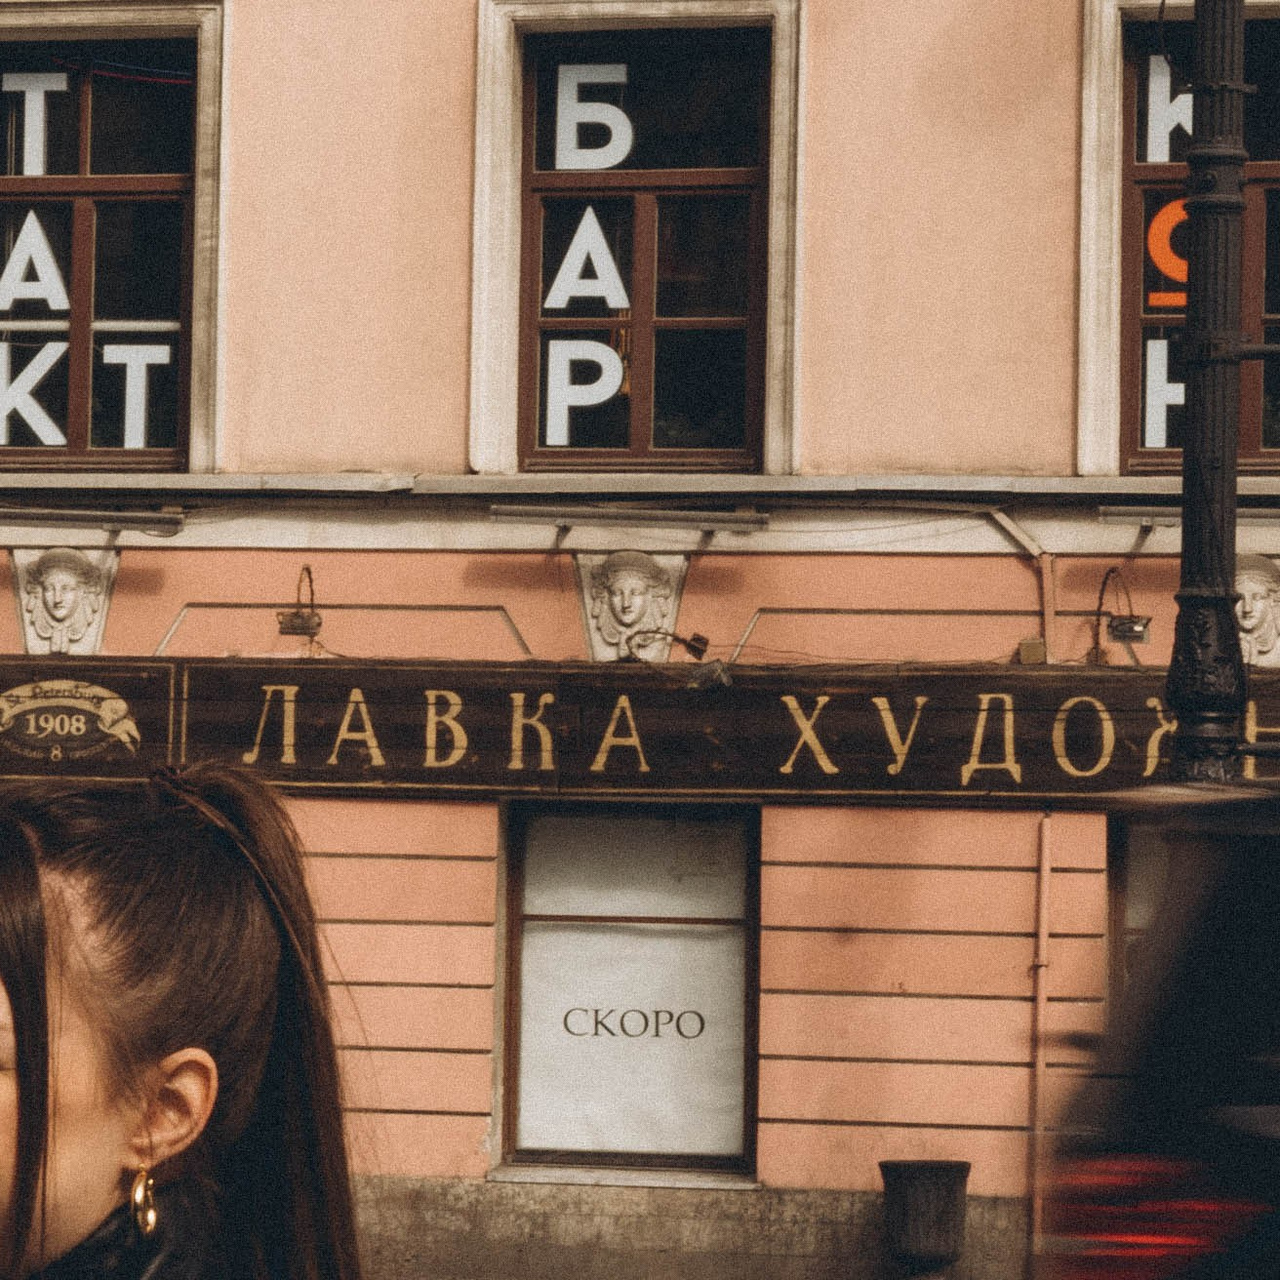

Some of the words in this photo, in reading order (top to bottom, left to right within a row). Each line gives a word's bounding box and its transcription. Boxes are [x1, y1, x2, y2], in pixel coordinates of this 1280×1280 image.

[543, 63, 634, 446] БАР
[25, 713, 87, 738] 1908
[242, 684, 650, 772] ЛАВКА
[563, 1008, 706, 1039] СКОРО
